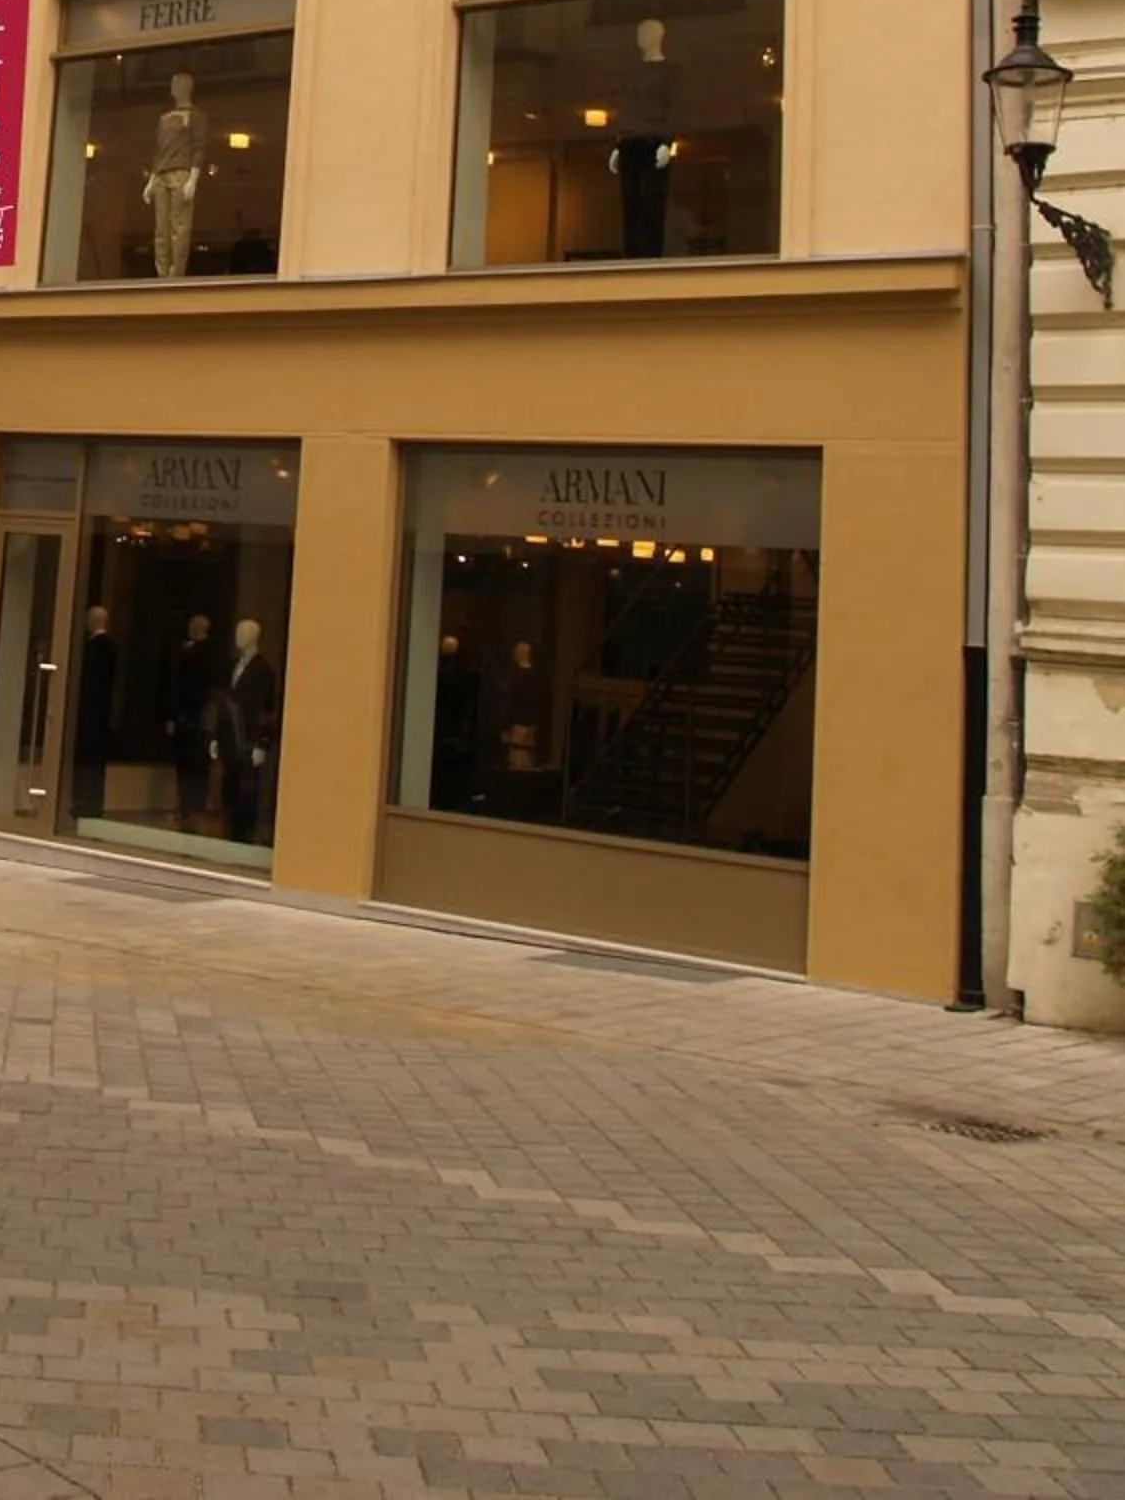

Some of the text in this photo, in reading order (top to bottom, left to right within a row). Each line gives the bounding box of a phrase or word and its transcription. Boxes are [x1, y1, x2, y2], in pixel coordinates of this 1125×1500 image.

[142, 455, 242, 491] ARMANI
[539, 467, 667, 506] ARMANI
[536, 510, 667, 529] COLLEZIONI
